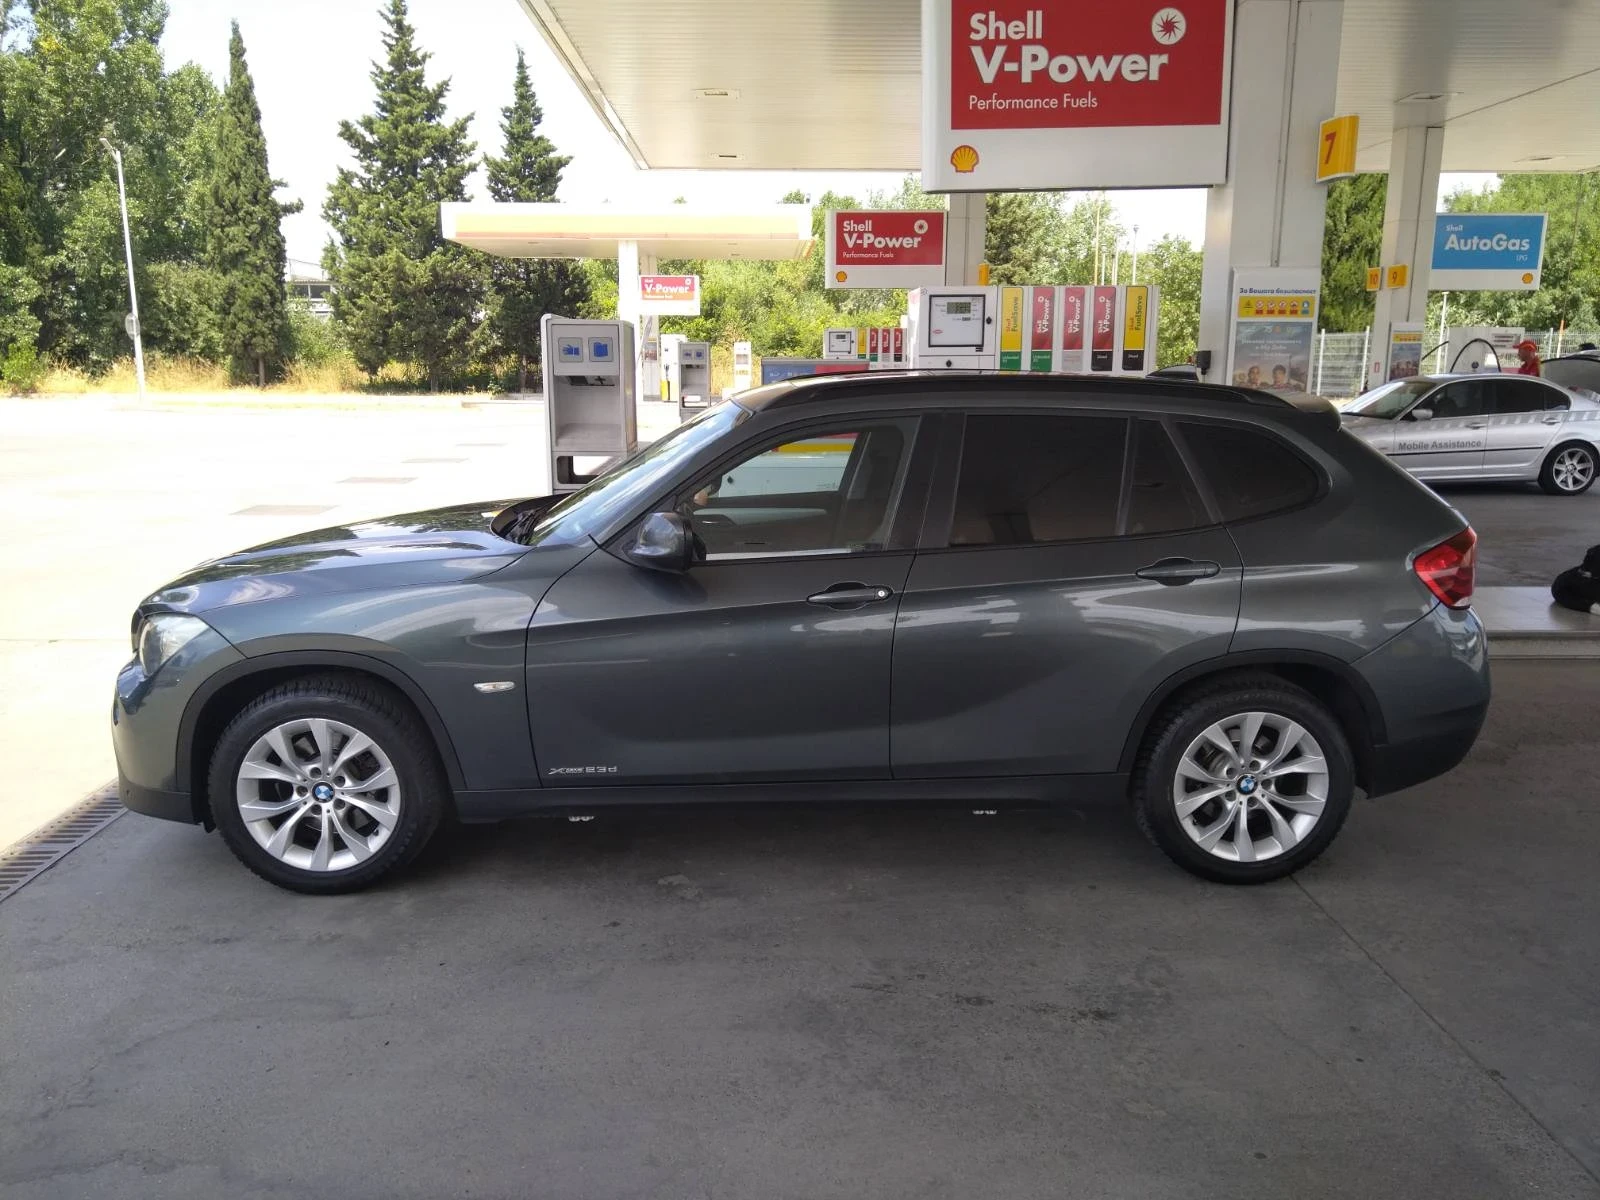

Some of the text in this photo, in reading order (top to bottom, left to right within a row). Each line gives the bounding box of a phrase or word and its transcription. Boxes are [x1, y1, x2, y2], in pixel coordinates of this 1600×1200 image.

[969, 10, 1043, 41] Shell
[969, 44, 1169, 84] V-Power
[969, 91, 1098, 110] Performance Fuels
[1325, 131, 1337, 165] 7
[843, 219, 872, 232] Shell
[1446, 224, 1464, 232] Shell
[843, 233, 921, 249] V-Power
[1444, 233, 1530, 251] AutoGas
[843, 250, 894, 259] Performance Fuels
[1370, 272, 1379, 285] 10
[1392, 271, 1398, 284] 9
[644, 283, 690, 293] V-Power
[1011, 296, 1019, 332] FuelSave
[1042, 298, 1050, 333] V-Power
[1073, 298, 1081, 333] V-Power
[1103, 298, 1111, 333] V-Power
[1134, 295, 1143, 331] FuelSave
[1398, 440, 1482, 451] Mobile Assistance
